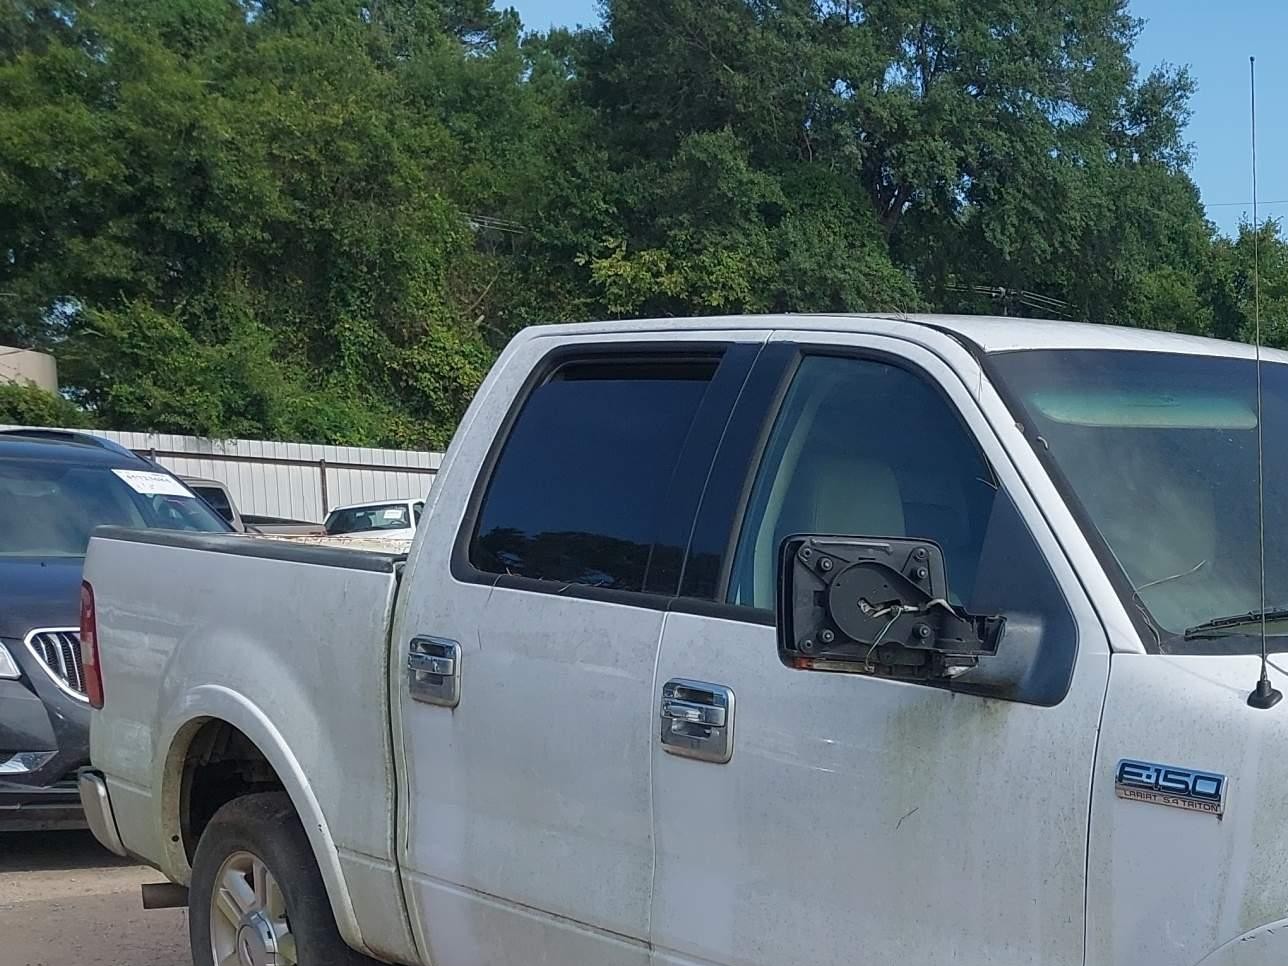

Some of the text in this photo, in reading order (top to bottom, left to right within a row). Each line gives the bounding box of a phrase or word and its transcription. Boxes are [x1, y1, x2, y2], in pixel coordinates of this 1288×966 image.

[1118, 762, 1222, 799] F-150
[1123, 789, 1158, 801] LARIAT
[1182, 800, 1218, 812] TRITON
